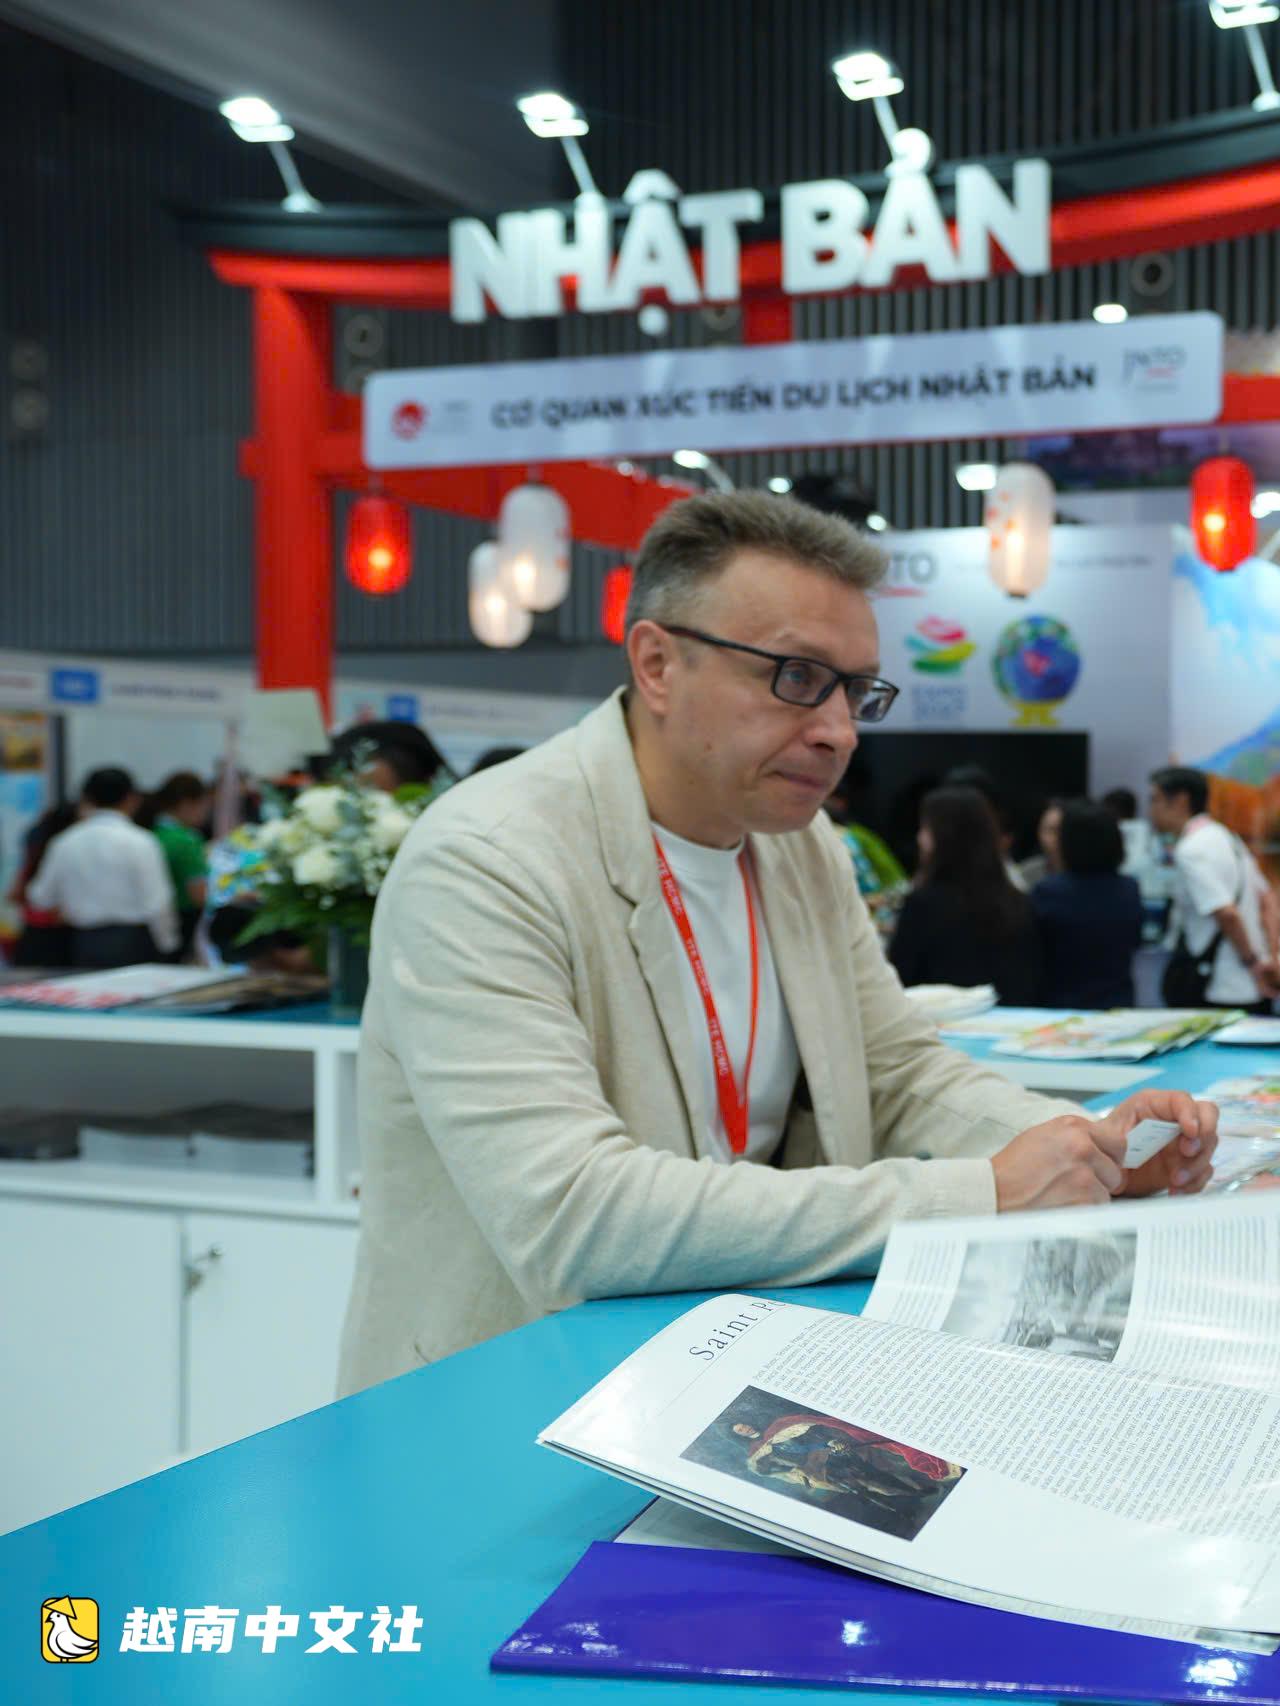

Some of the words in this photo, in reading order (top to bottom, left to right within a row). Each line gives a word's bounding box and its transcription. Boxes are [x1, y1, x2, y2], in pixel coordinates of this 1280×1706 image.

[449, 168, 763, 336] NHẬT
[780, 127, 1051, 294] BẢN
[540, 395, 628, 430] QUAN
[630, 385, 697, 418] XÚC
[705, 376, 776, 415] TIẾN
[781, 380, 831, 409] DU
[836, 375, 909, 410] LỊCH
[918, 361, 1011, 404] NHẬT
[1021, 354, 1097, 393] BẢN
[688, 1312, 759, 1362] Saint
